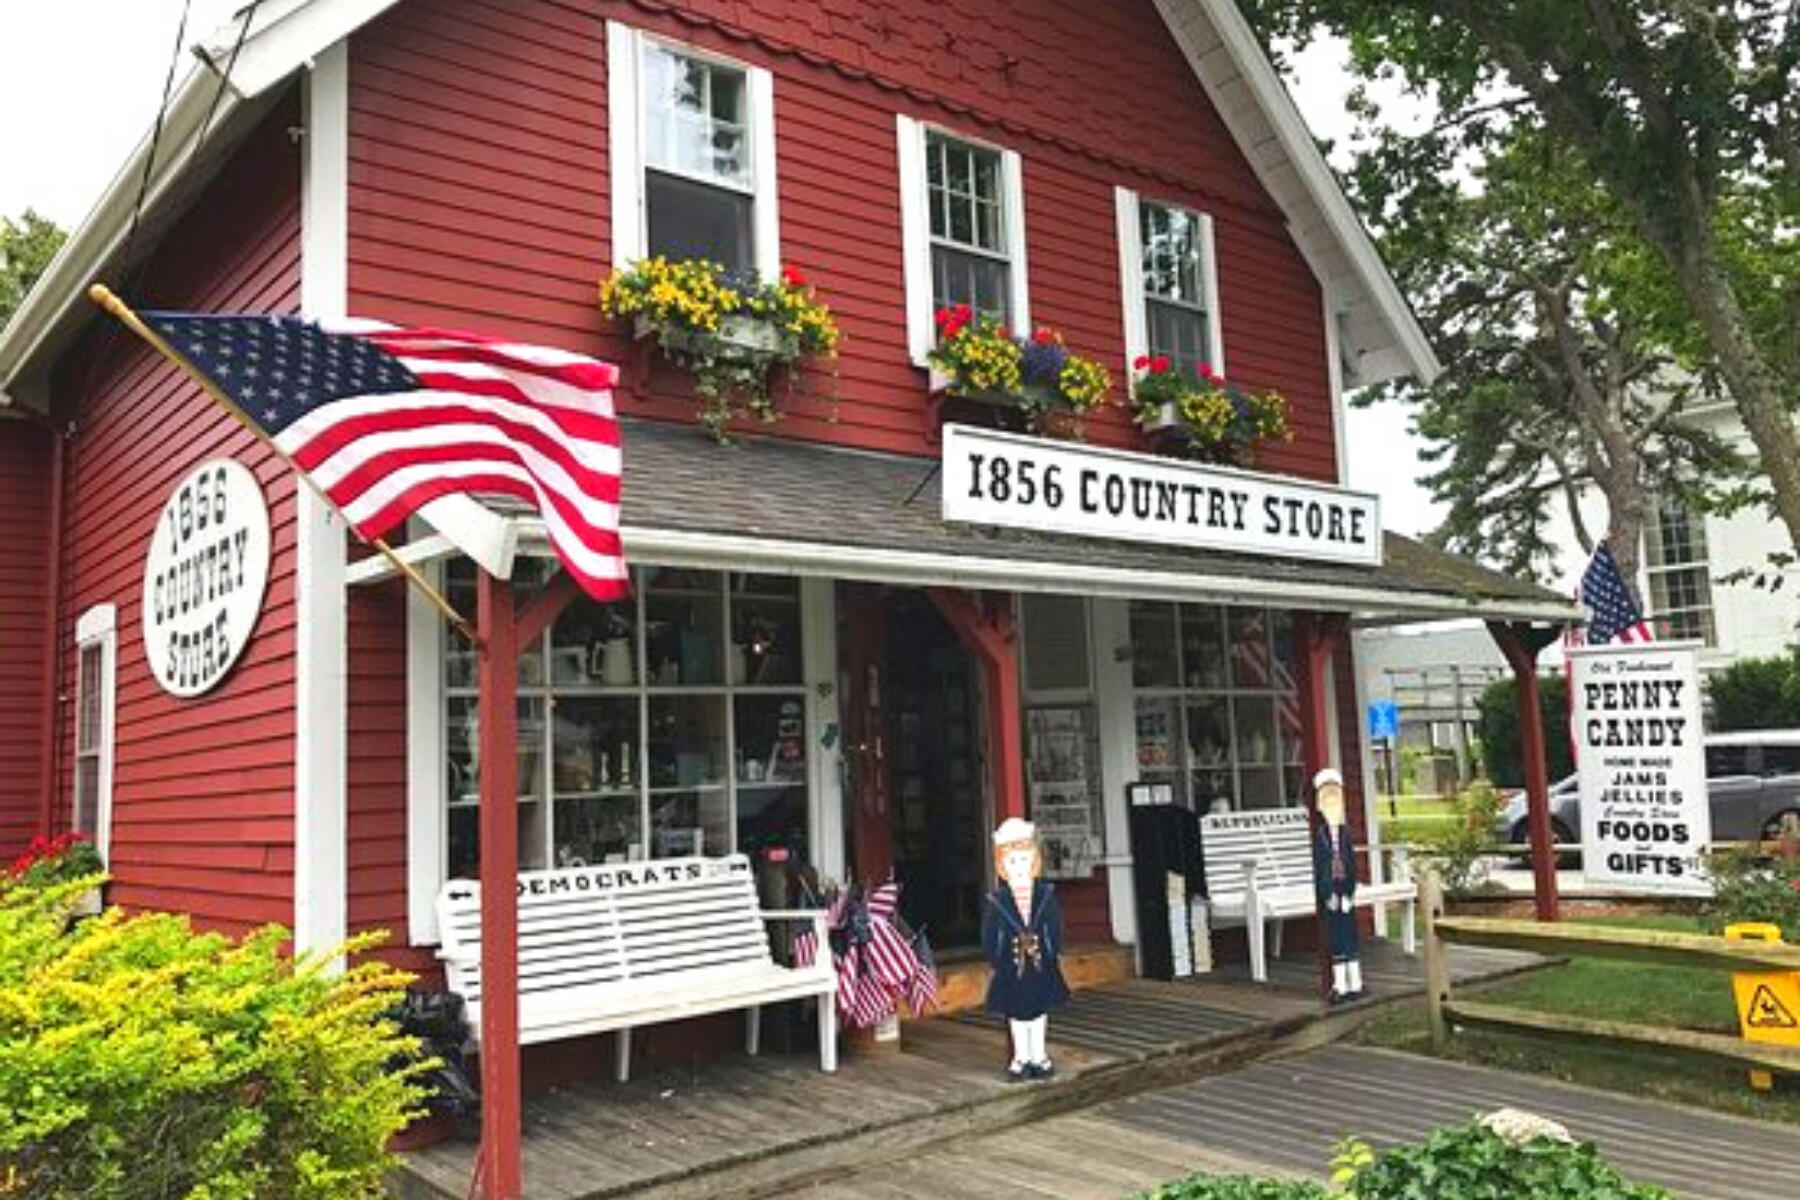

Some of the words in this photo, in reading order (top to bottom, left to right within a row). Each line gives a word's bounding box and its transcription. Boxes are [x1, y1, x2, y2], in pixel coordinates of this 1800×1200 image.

[168, 466, 228, 555] 1856
[968, 453, 1064, 508] 1856
[1079, 470, 1248, 530] COUNTRY
[1264, 495, 1367, 544] STORE
[154, 526, 247, 625] COUNTRY
[166, 608, 229, 688] STORE
[1583, 679, 1684, 711] PENNY
[1587, 717, 1686, 748] CANDY
[1640, 757, 1672, 768] MADE
[1612, 771, 1667, 786] JAMS
[1600, 788, 1683, 805] JELLIES
[1597, 820, 1690, 844] FOODS
[1607, 853, 1684, 877] GIFTS
